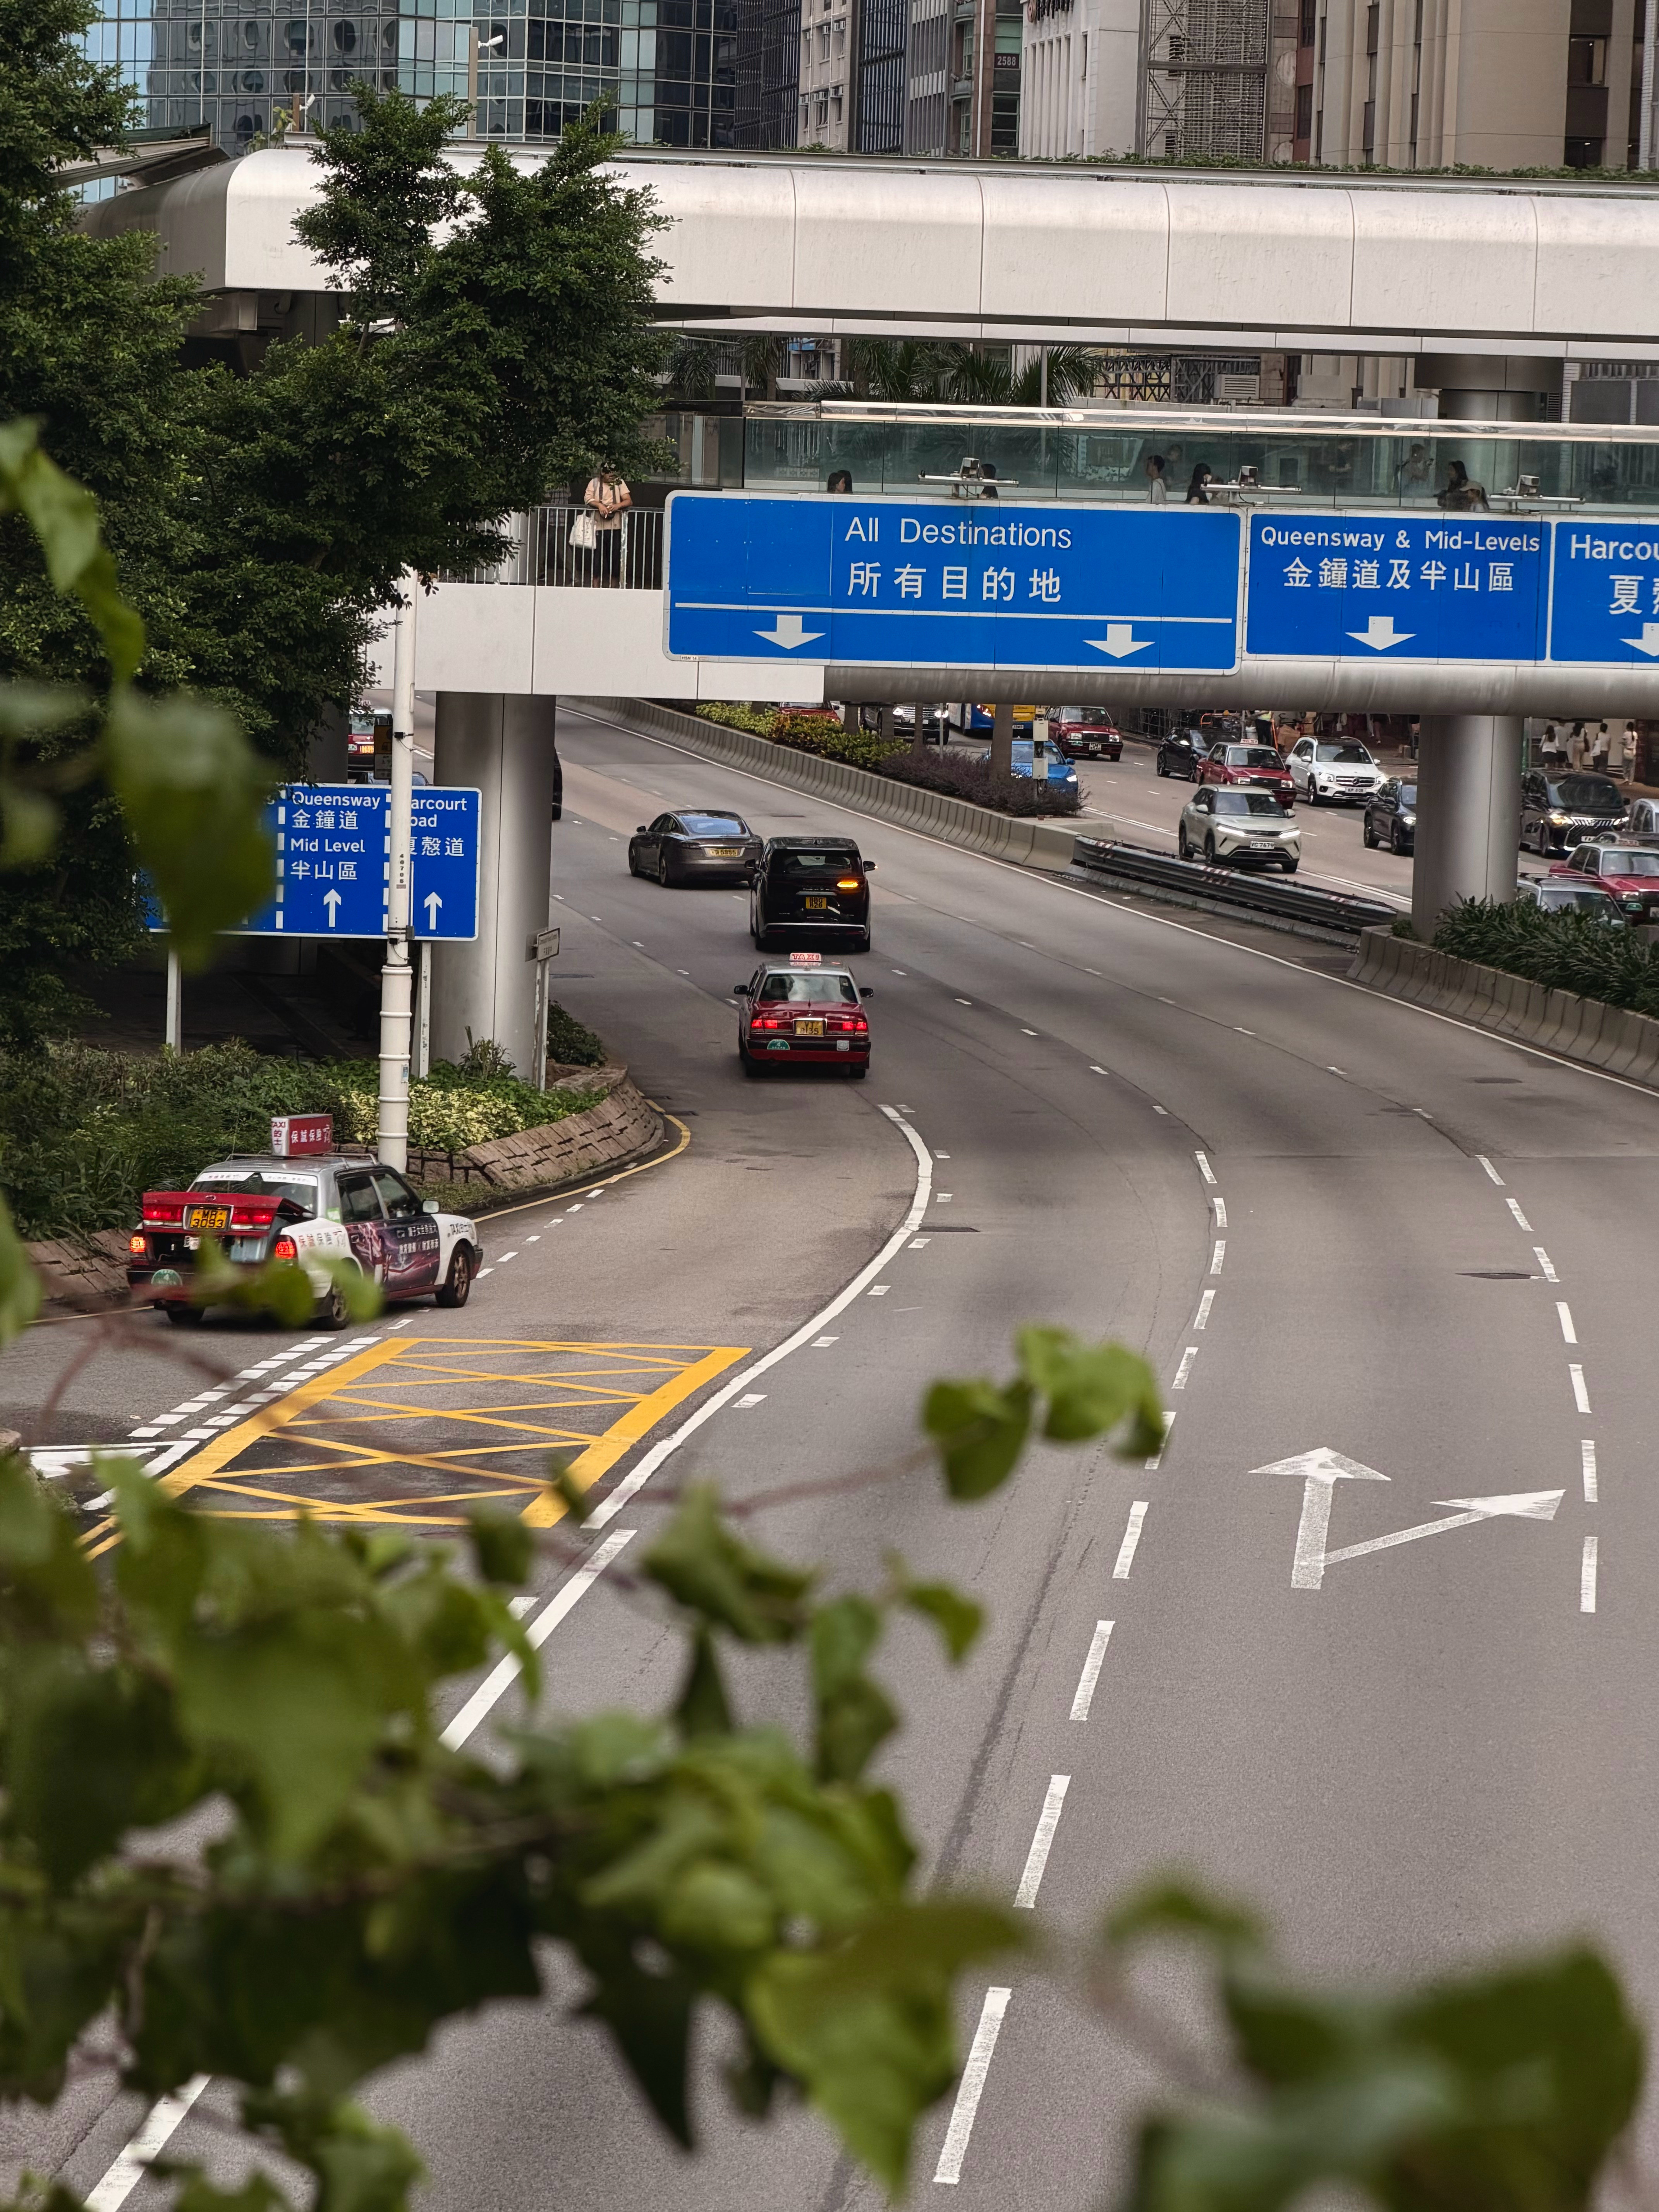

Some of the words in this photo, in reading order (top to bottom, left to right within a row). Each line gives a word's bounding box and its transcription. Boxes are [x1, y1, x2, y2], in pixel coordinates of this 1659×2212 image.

[997, 56, 1016, 66] 2588
[845, 517, 879, 542] All
[900, 518, 1072, 549] Destinations
[1261, 526, 1385, 551] Queensway
[1396, 530, 1410, 548] &
[1425, 531, 1540, 551] Mid-Levels
[848, 562, 1061, 603] 所有目的地
[1283, 557, 1514, 592] 金鐘道及半山區
[292, 791, 380, 810] Queensway
[411, 798, 467, 811] arcourt
[292, 809, 359, 830] 金鐘道
[410, 814, 437, 827] oad
[291, 838, 318, 852] Mid
[325, 839, 365, 852] Level
[290, 860, 357, 880] 半山區
[192, 1218, 224, 1228] 3093
[202, 1210, 218, 1219] MR
